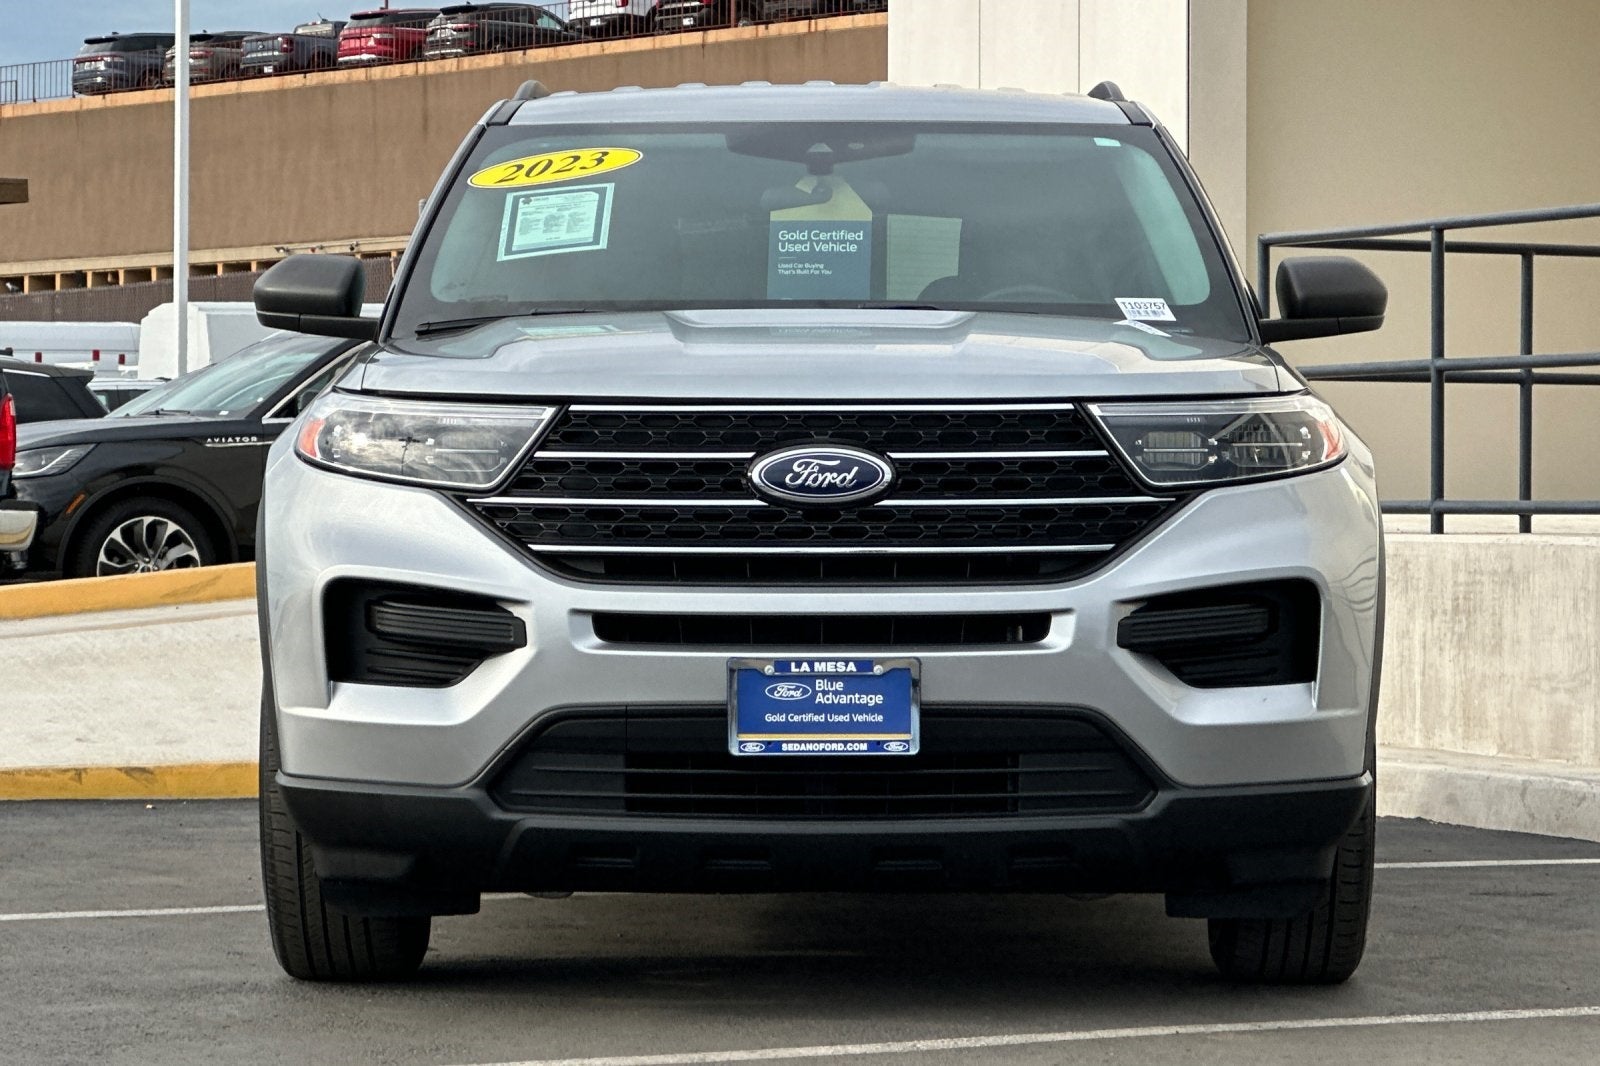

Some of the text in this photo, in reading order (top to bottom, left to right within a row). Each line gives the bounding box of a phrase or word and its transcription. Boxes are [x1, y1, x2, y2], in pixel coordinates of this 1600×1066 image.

[495, 151, 609, 184] 2023
[778, 230, 863, 240] Gold Certified
[778, 241, 858, 252] Used Vehicle
[1120, 301, 1165, 310] T103757
[784, 458, 859, 488] Ford
[790, 661, 857, 672] LA MESA
[815, 679, 844, 691] Blue
[773, 685, 803, 698] Ford
[815, 692, 884, 706] Advantage
[764, 713, 884, 722] Gold Certified Used Vehicle
[781, 742, 868, 751] SEDANOFORD.COM
